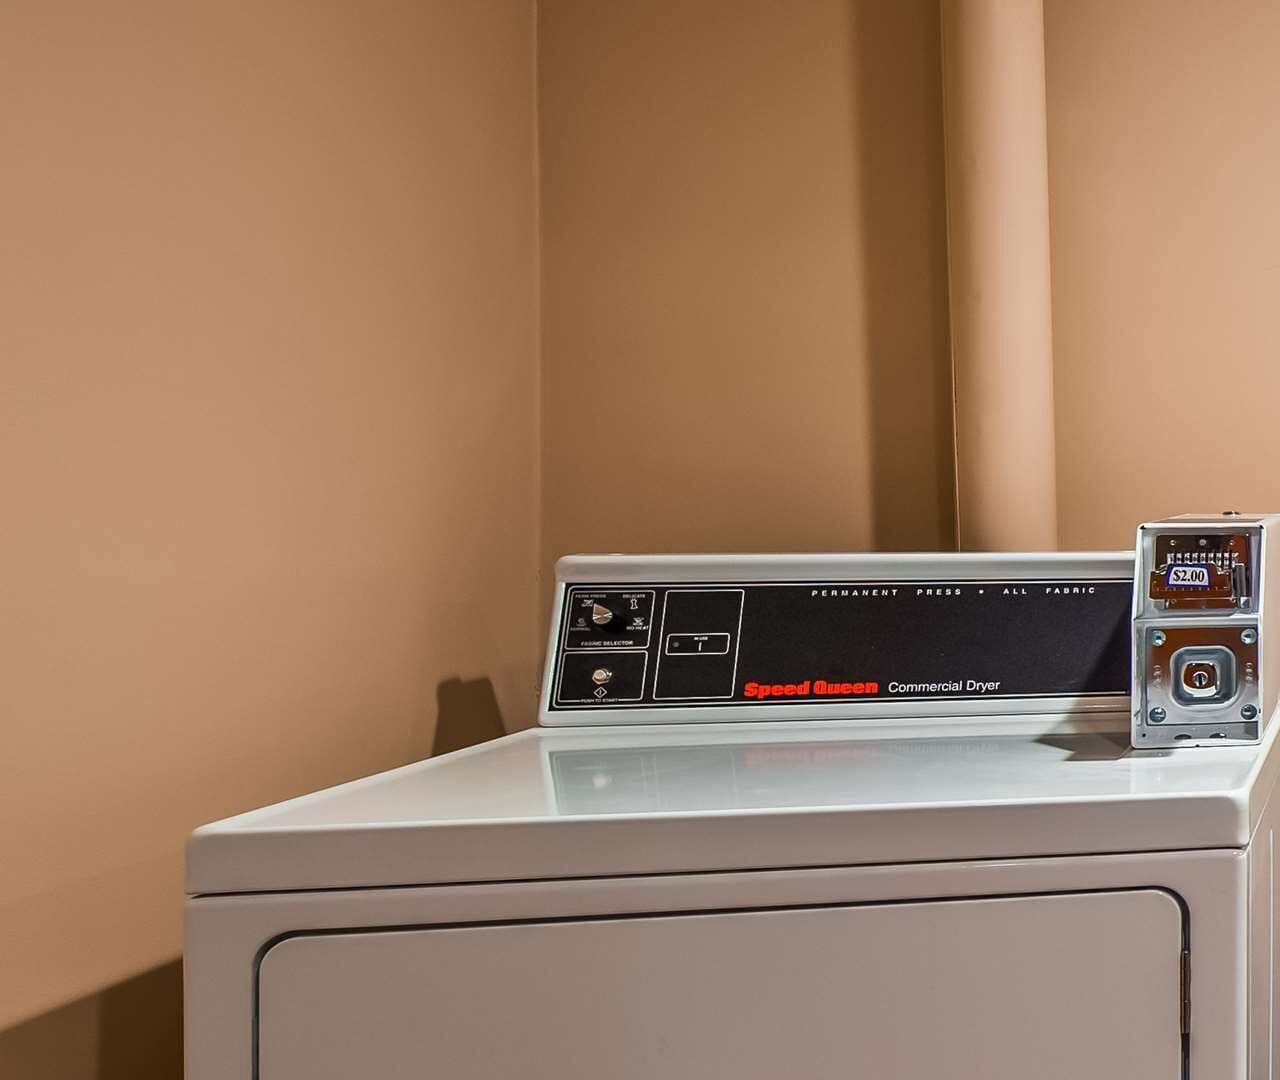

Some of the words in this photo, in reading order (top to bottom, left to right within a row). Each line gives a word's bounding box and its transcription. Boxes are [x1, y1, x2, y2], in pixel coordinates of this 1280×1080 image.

[1173, 569, 1205, 582] $2.00
[811, 589, 898, 597] PERMANENT
[916, 588, 961, 596] PRESS
[744, 680, 811, 699] Speed
[813, 680, 879, 695] Queen
[888, 680, 963, 693] Commercial
[966, 680, 1000, 693] Dryer
